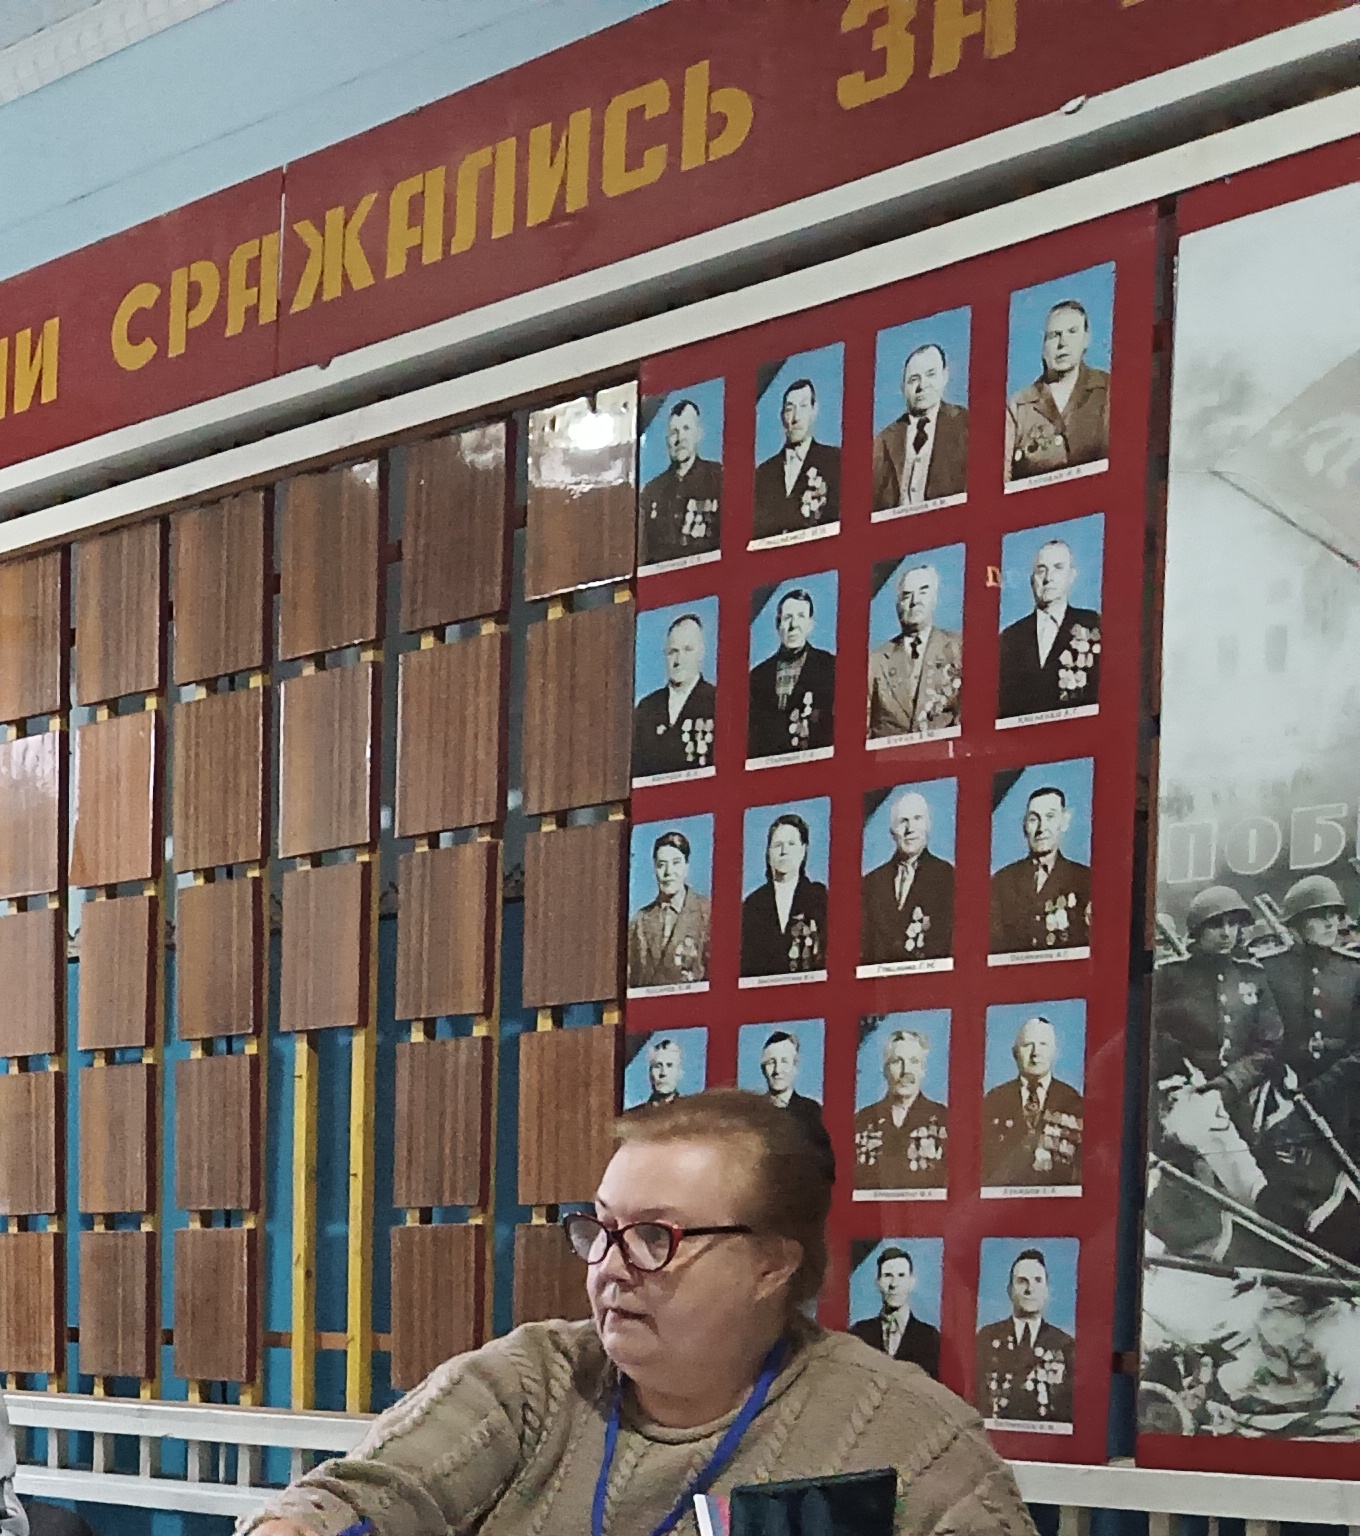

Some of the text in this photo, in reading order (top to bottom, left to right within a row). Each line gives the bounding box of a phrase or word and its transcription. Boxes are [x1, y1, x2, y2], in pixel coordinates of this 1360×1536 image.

[110, 59, 755, 373] СРАЖАЛИСЬ
[836, 0, 1018, 111] ЗА
[1166, 802, 1360, 884] ПОБ
